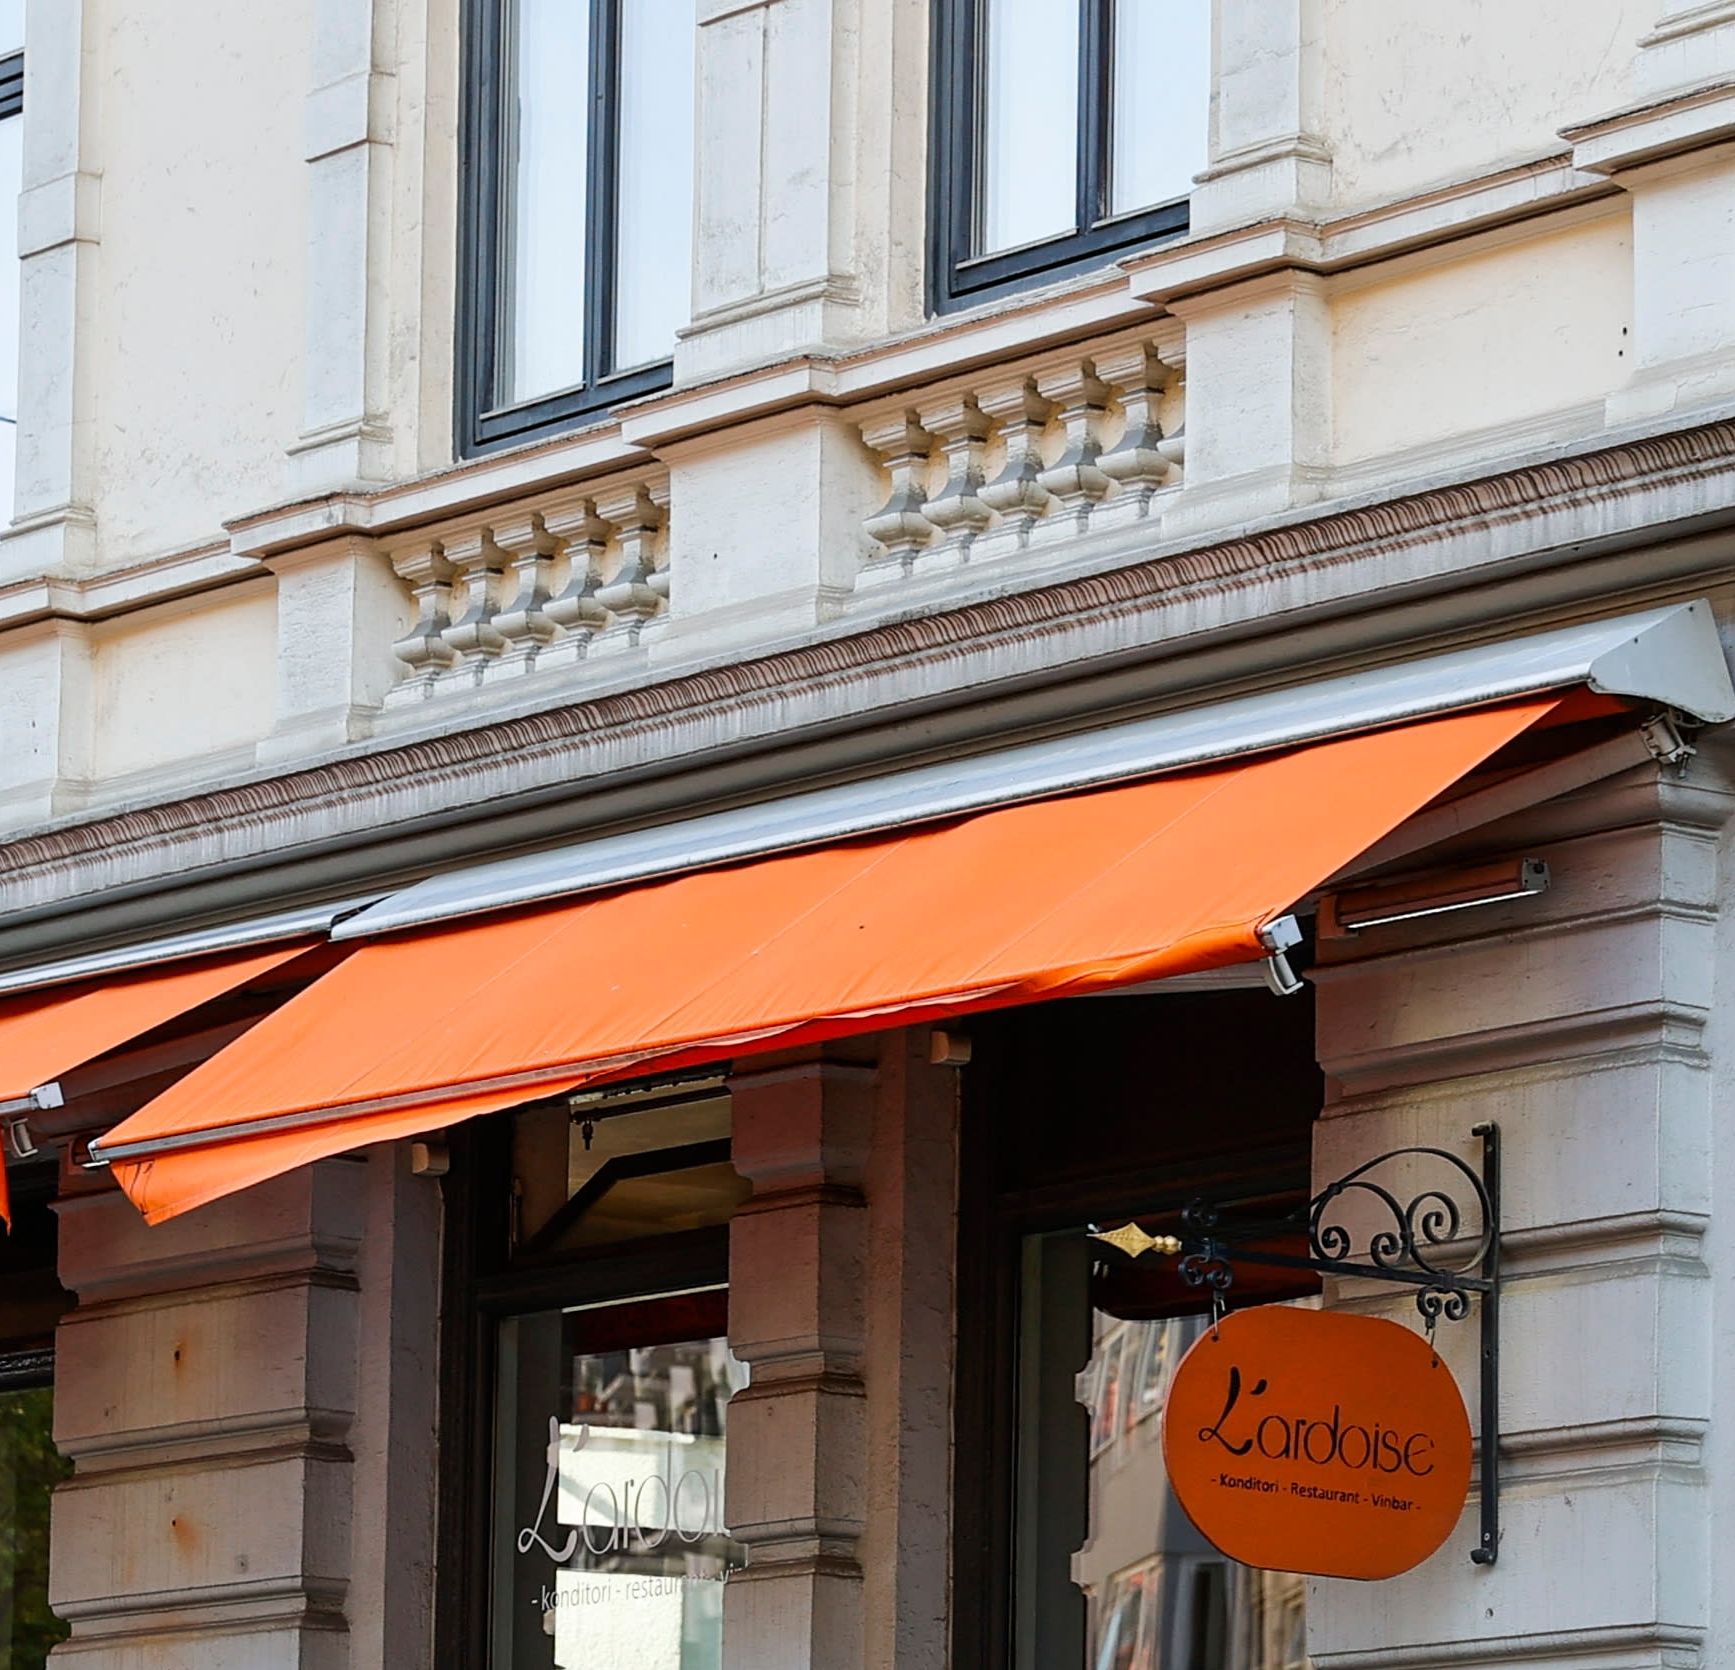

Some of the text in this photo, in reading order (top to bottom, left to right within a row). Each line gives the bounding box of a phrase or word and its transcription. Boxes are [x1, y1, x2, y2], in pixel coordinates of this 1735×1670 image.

[1198, 1366, 1435, 1476] L'ardoise
[518, 1415, 721, 1562] L'ardoi
[1219, 1473, 1279, 1493] Konditori
[1290, 1482, 1360, 1505] Restaurant
[1371, 1494, 1413, 1511] Vinbar
[541, 1578, 612, 1611] konditori
